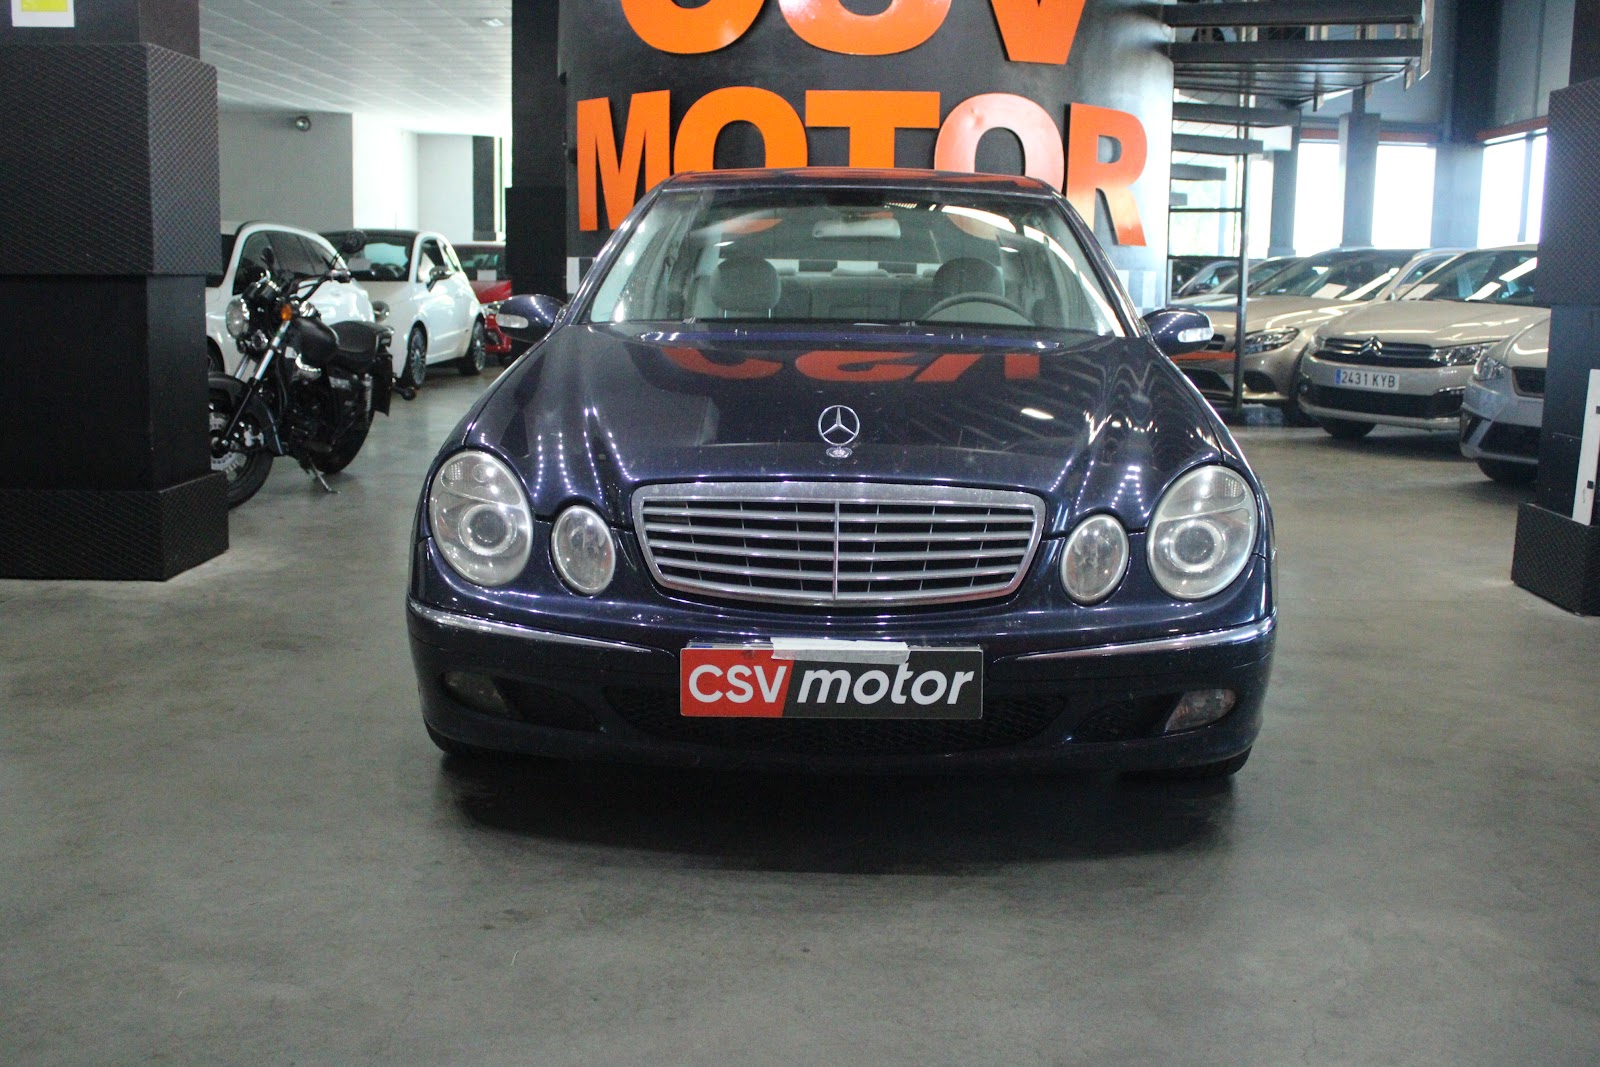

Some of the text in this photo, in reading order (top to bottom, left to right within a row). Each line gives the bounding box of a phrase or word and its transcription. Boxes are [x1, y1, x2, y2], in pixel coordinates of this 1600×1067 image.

[577, 86, 1148, 247] MOTOR
[1341, 371, 1396, 388] 2431 KYB
[688, 661, 975, 706] CSV motor
